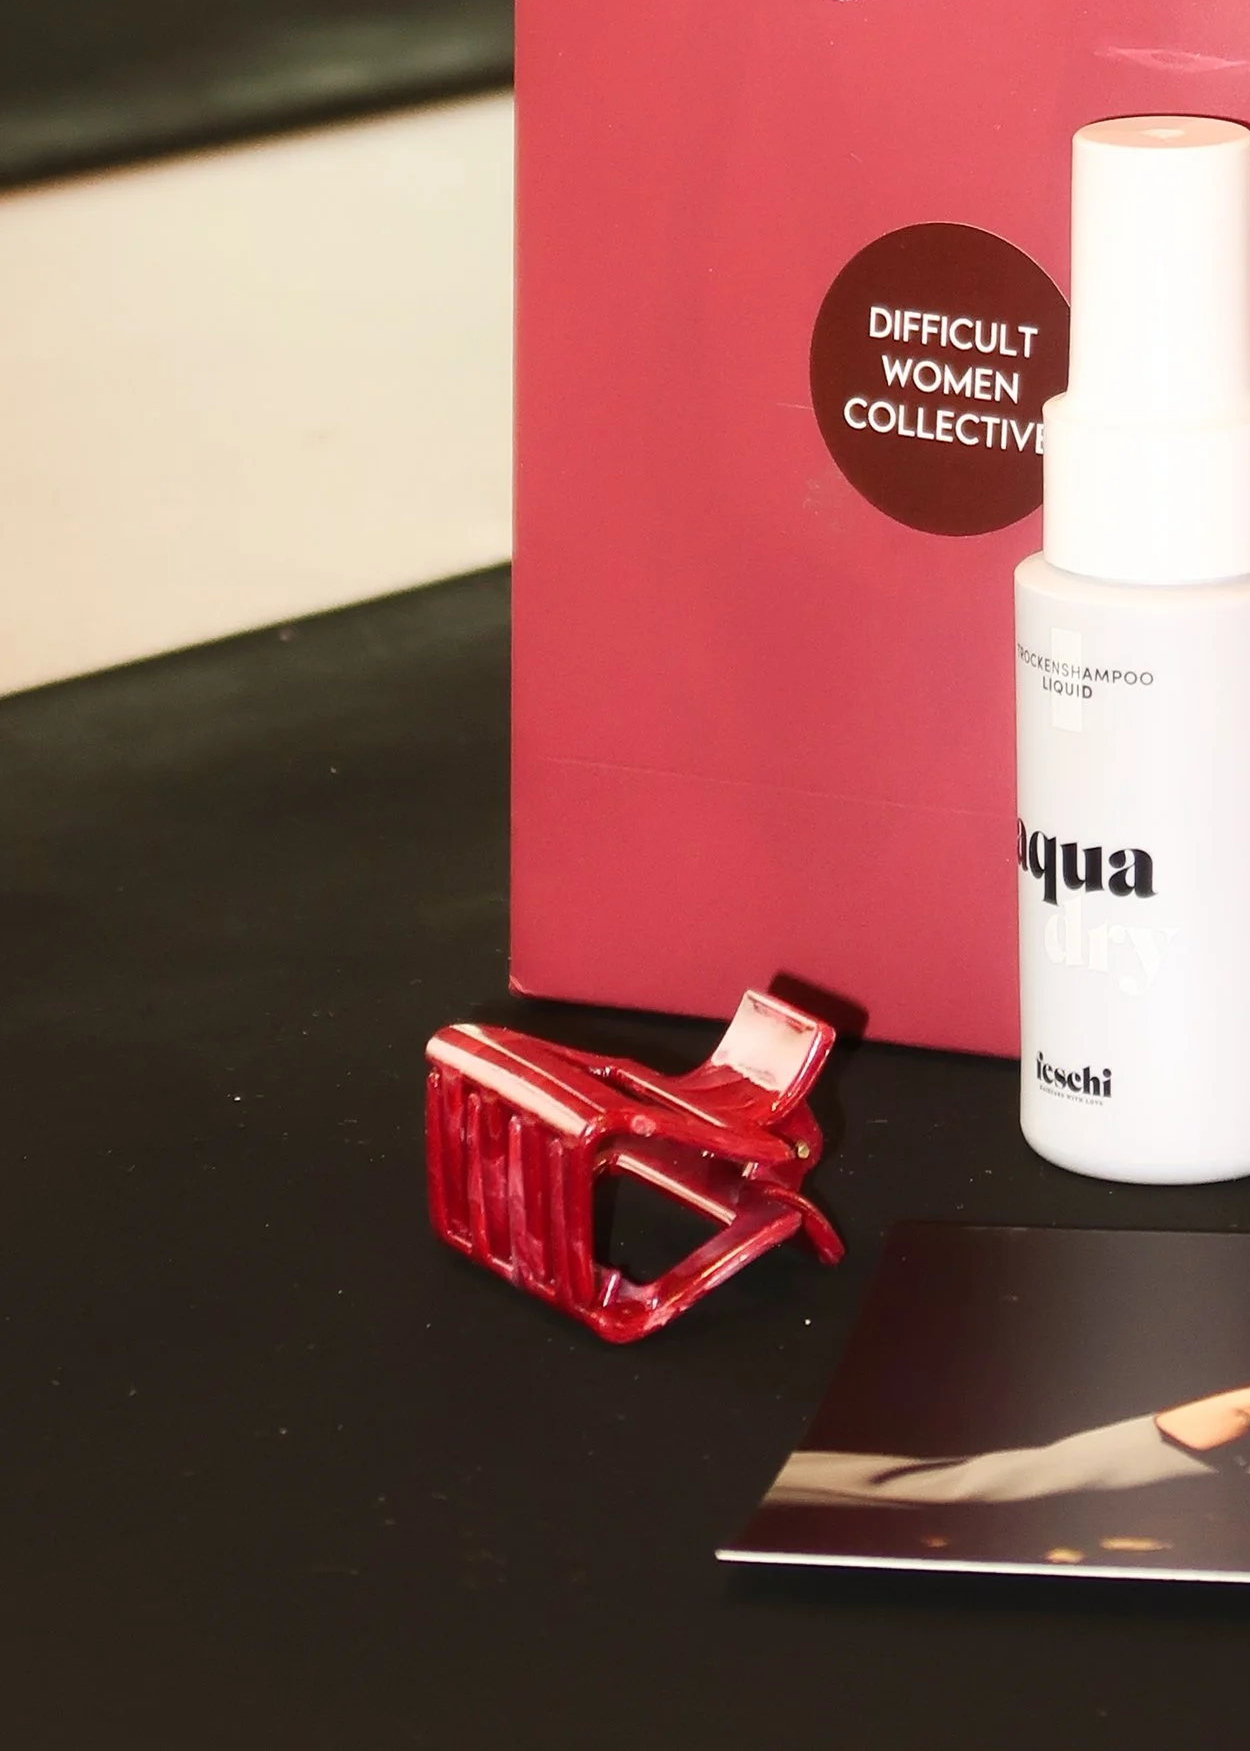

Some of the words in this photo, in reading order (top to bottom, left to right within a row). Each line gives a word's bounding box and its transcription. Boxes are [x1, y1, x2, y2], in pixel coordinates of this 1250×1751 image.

[869, 306, 1038, 358] DIFFICULT
[881, 354, 1019, 404] WOMEN
[1042, 675, 1093, 699] LIQUID
[1017, 818, 1158, 907] aqua
[1044, 895, 1183, 997] dry
